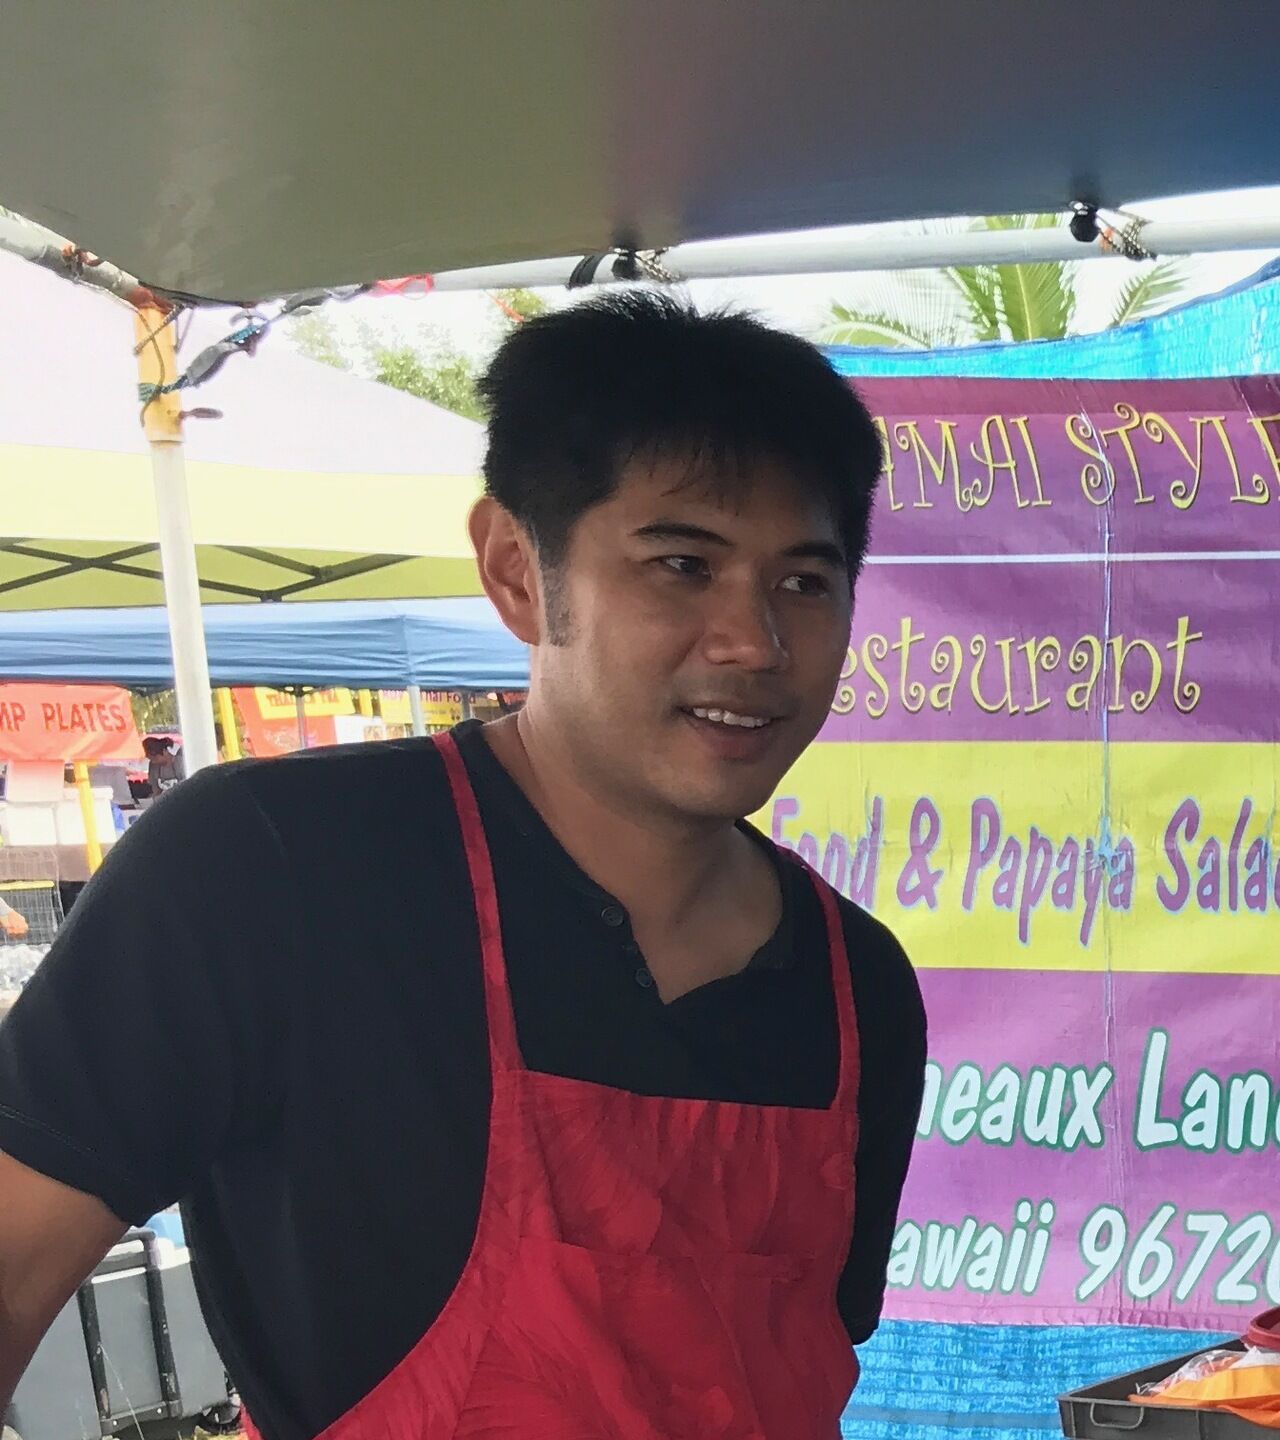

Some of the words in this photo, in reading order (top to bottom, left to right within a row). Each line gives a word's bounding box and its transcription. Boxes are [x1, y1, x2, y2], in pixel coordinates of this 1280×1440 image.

[42, 702, 127, 732] PLATES
[895, 796, 945, 910] &
[961, 797, 1135, 947] Papaya
